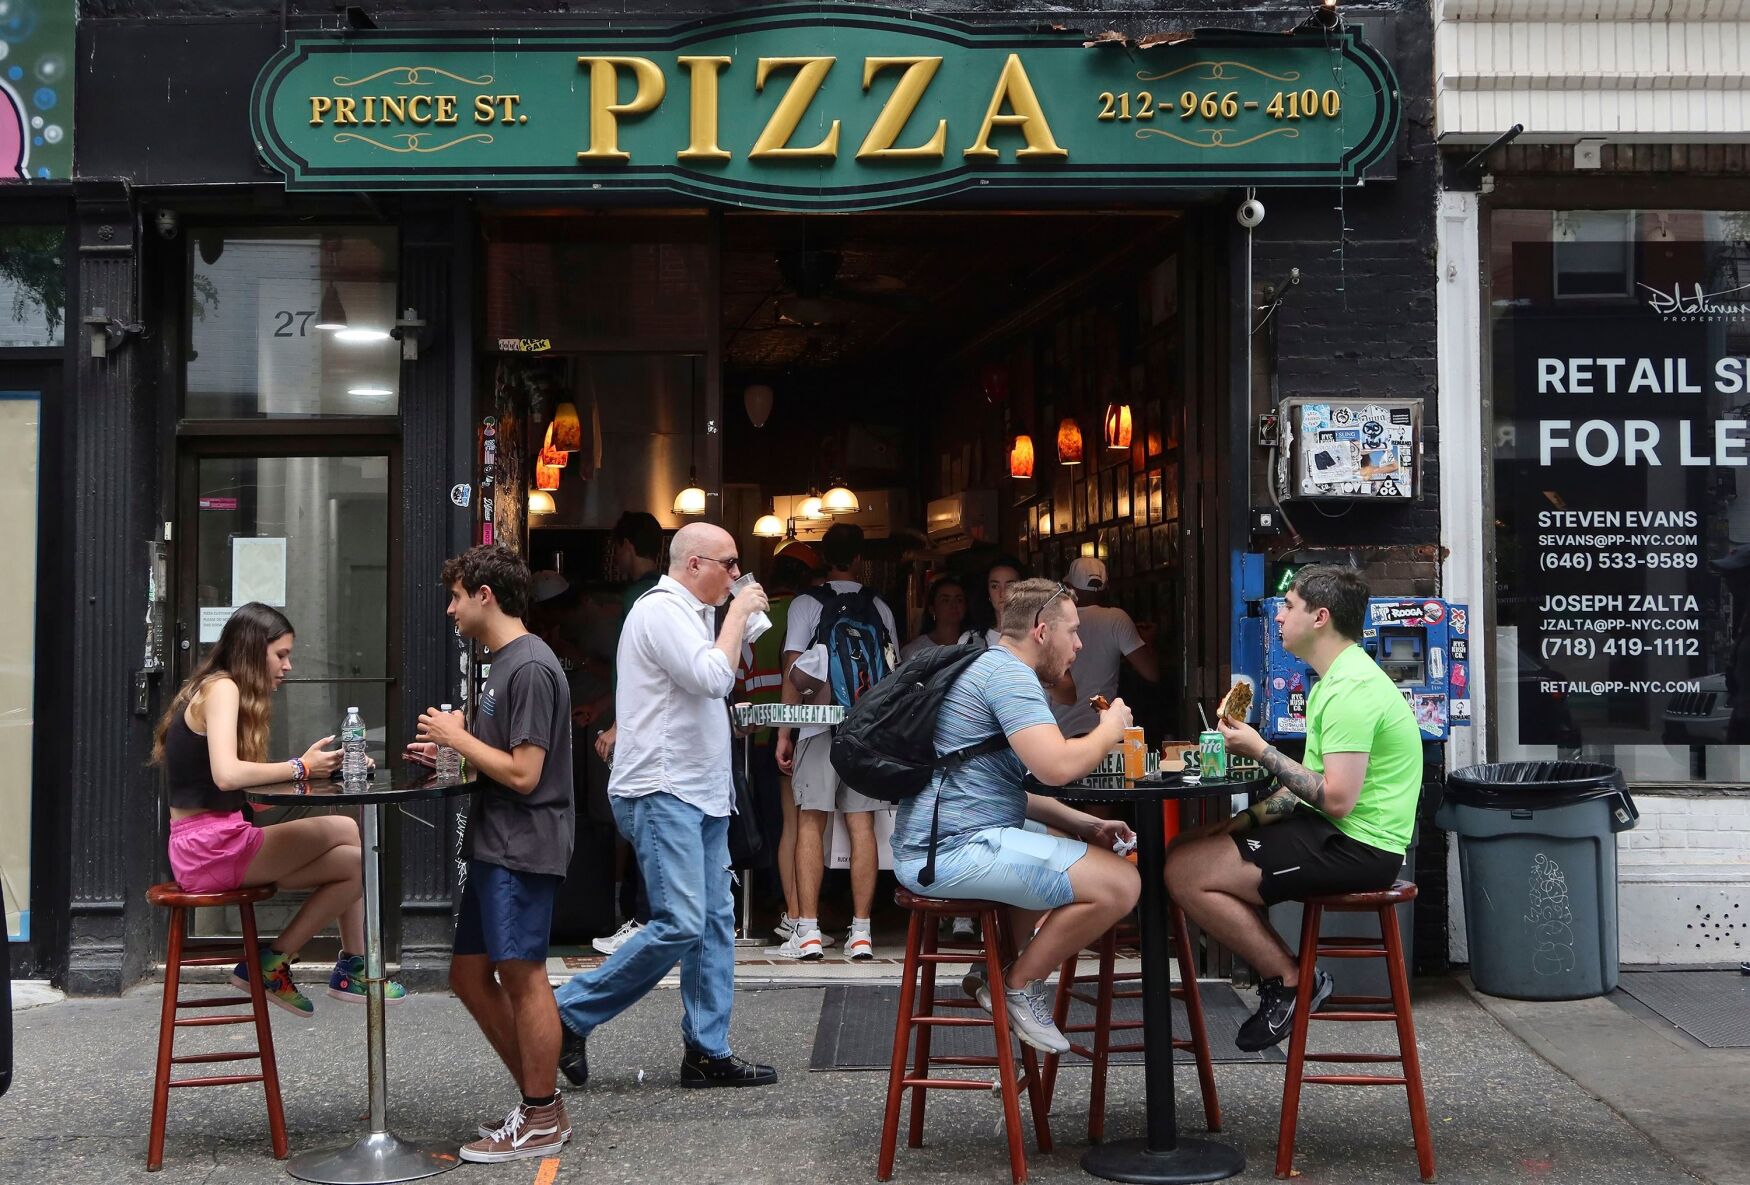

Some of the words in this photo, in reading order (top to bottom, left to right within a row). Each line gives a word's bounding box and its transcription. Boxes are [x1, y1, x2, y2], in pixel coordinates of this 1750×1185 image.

[309, 95, 458, 124] PRINCE
[475, 95, 529, 123] ST.
[576, 54, 1070, 160] PIZZA
[1097, 89, 1340, 119] 212-966-4100
[274, 311, 317, 337] 27
[1538, 358, 1702, 394] RETAIL
[1714, 358, 1750, 394] S
[1540, 420, 1663, 467] FOR
[1680, 420, 1748, 466] LE
[1538, 511, 1621, 528] STEVEN
[1626, 511, 1698, 528] EVANS
[1539, 534, 1698, 549] SEVANS@PP-NYC.COM
[1540, 552, 1593, 571] (646)
[1598, 552, 1698, 569] 533-9589
[1539, 595, 1623, 612] JOSEPH
[1628, 595, 1700, 612] ZALTA
[1540, 619, 1699, 633] JZALTA@PP-NYC.COM
[1541, 637, 1596, 659] (718)
[1603, 638, 1700, 656] 419-1112
[1541, 681, 1700, 696] RETAIL@PP-NYC.COM
[771, 704, 787, 721] ONE
[788, 705, 809, 722] SLICE
